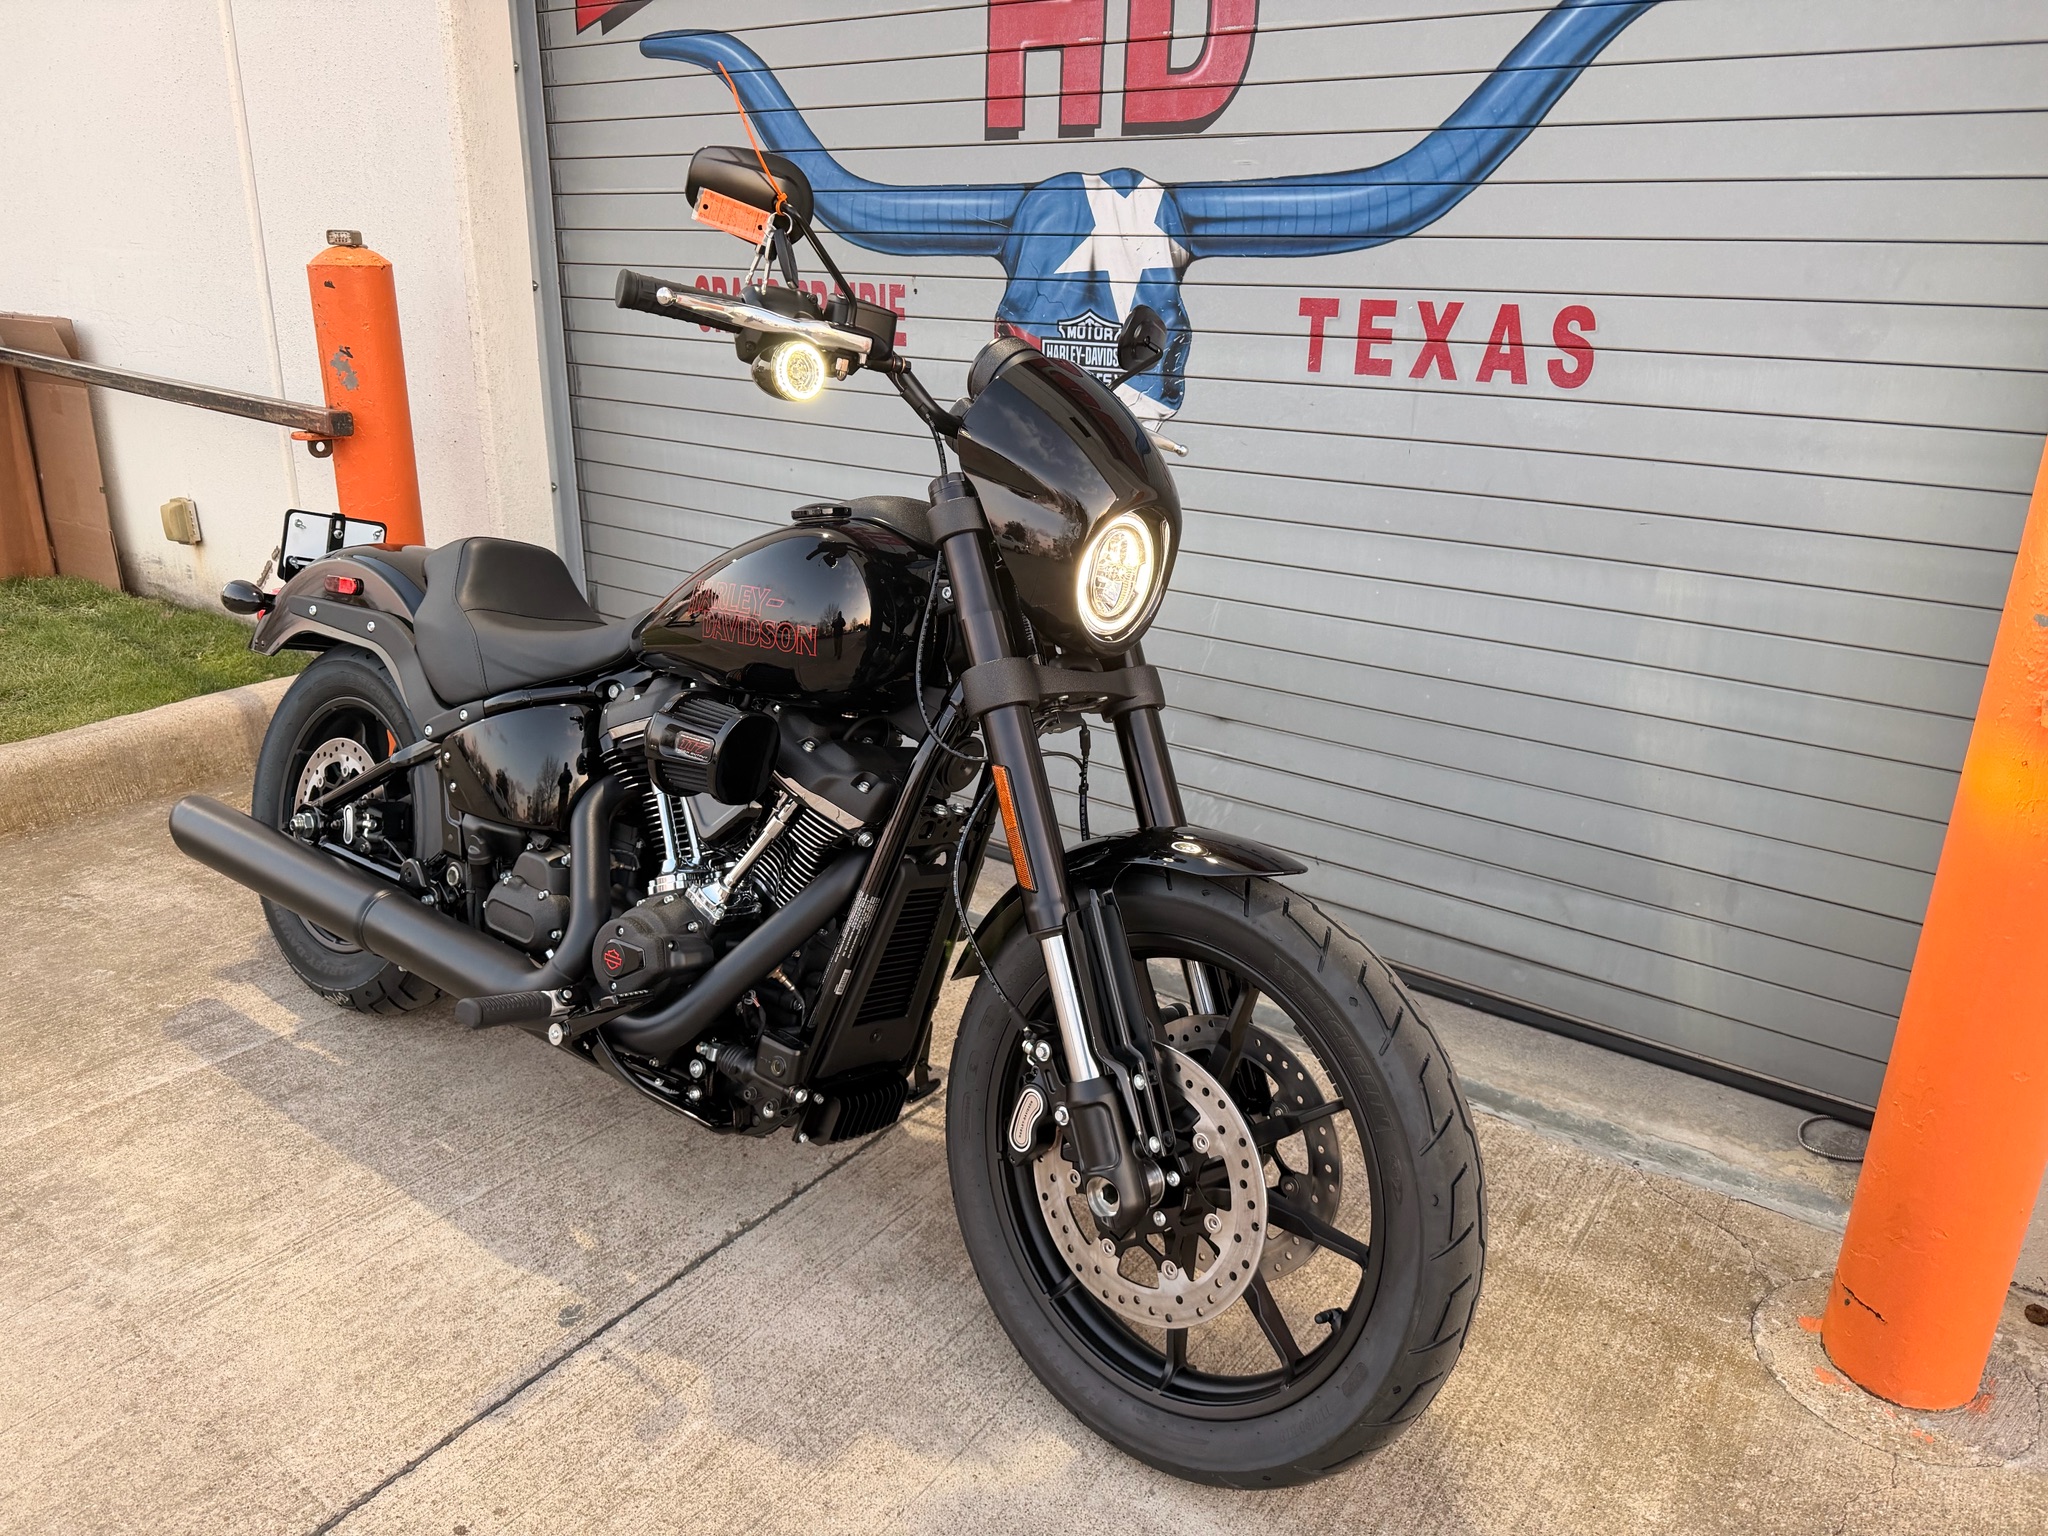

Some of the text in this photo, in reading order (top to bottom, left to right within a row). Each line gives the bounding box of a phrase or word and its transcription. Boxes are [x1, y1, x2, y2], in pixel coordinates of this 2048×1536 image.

[1066, 325, 1114, 342] MOTOR
[1298, 297, 1597, 390] TEXAS
[1046, 343, 1120, 367] HARLEY-DAVIDS
[702, 610, 817, 657] DAVIDSON
[680, 738, 711, 754] 117
